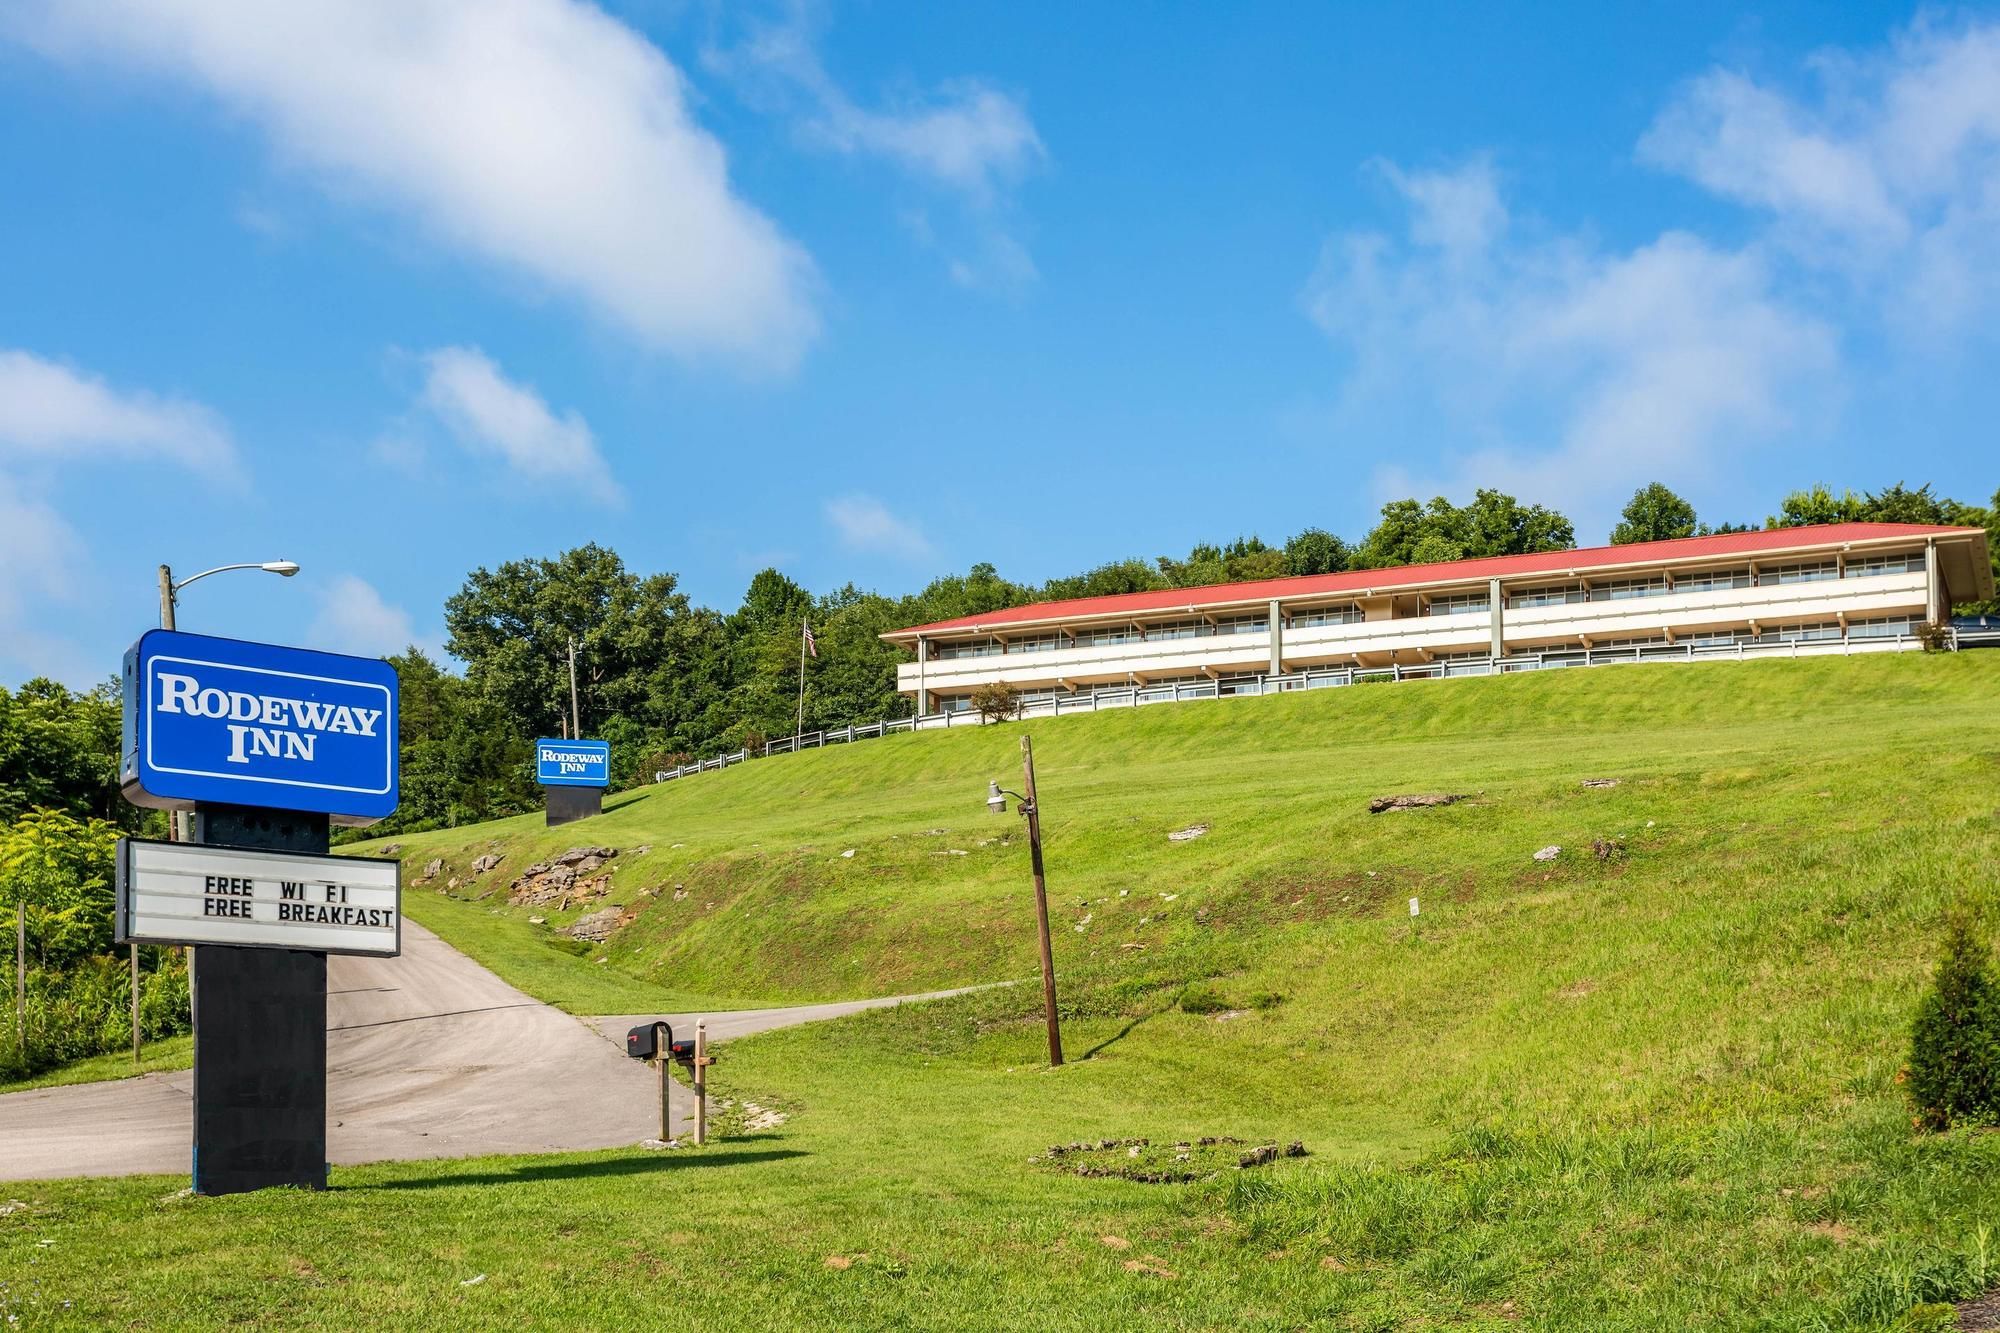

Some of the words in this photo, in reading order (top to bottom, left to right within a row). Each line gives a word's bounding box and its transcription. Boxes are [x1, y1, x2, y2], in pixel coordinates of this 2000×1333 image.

[157, 672, 382, 737] RODEWAY
[227, 724, 317, 764] INN
[541, 749, 605, 764] RODEWAY
[560, 762, 586, 774] INN
[205, 876, 253, 896] FREE
[280, 882, 304, 900] WI
[326, 885, 347, 903] FI
[204, 898, 252, 918] FREE
[279, 903, 393, 928] BREAKFAST
